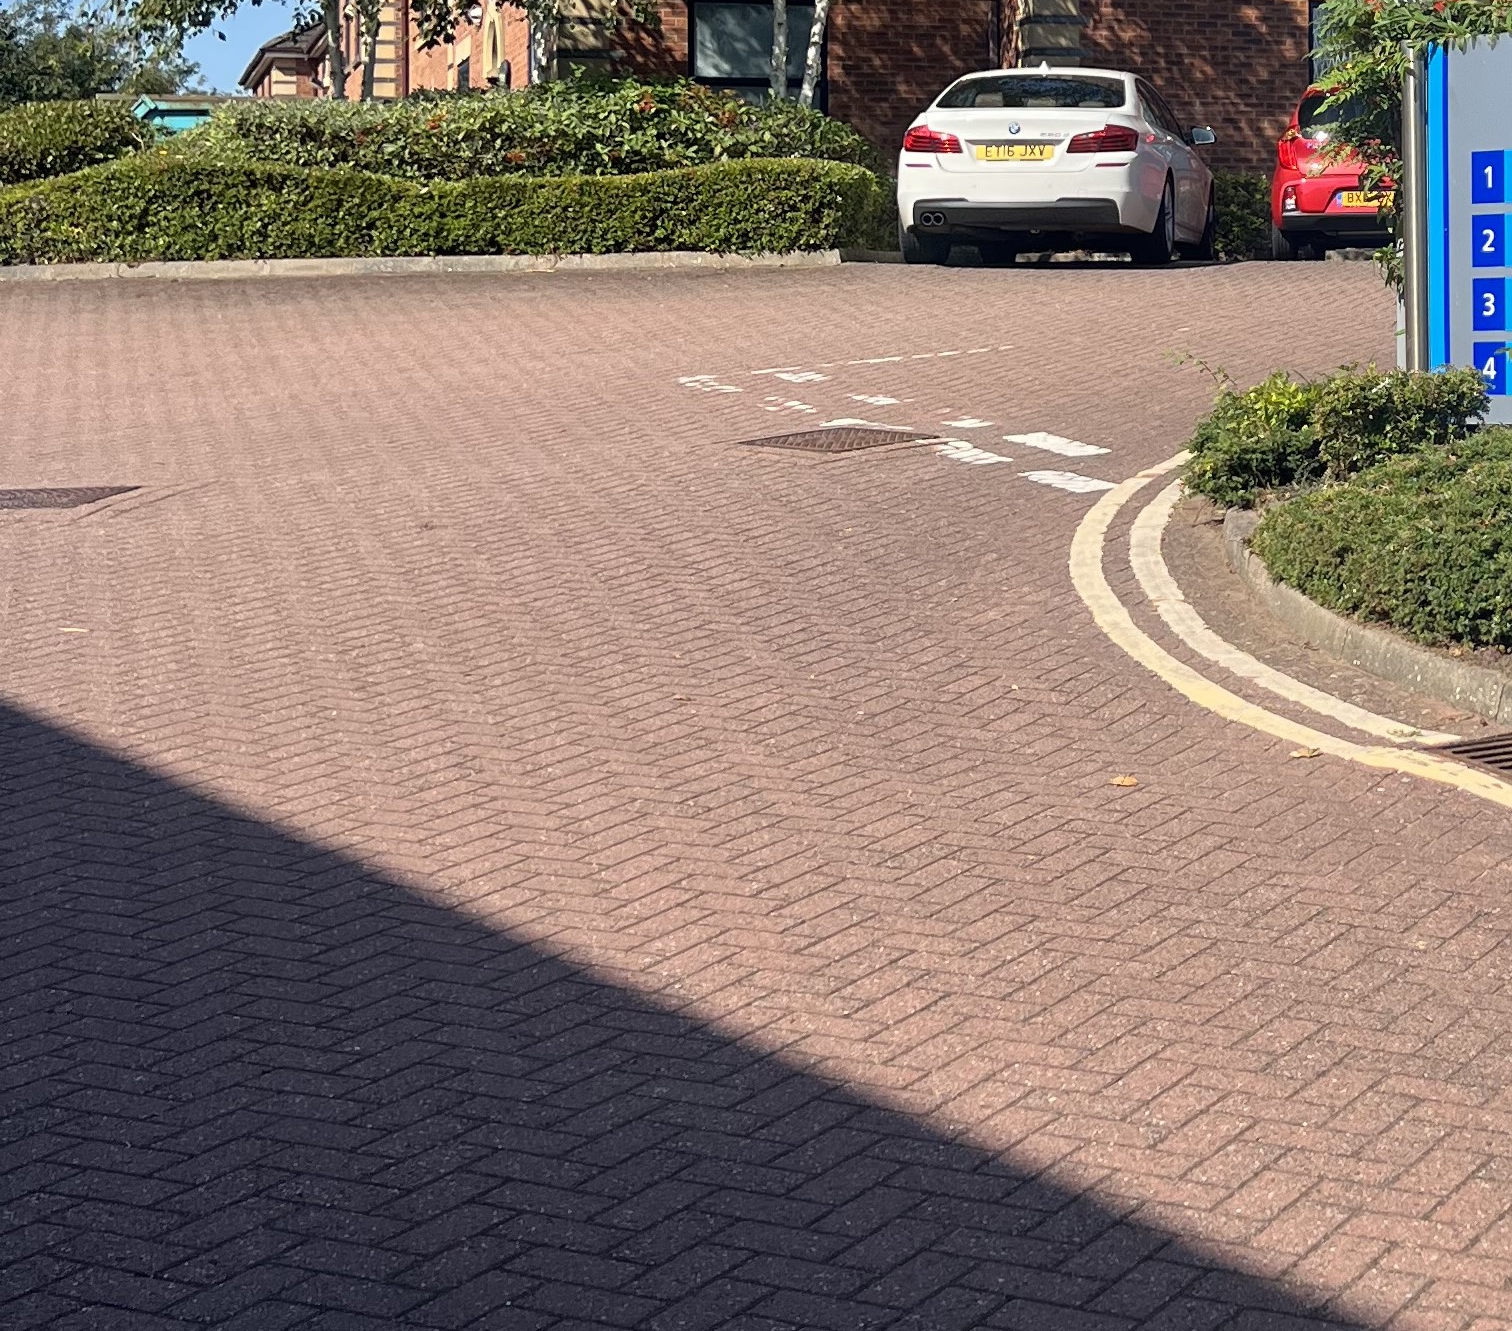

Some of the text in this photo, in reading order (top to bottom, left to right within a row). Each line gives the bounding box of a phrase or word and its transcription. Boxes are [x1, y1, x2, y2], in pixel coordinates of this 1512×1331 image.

[1484, 165, 1493, 188] 1
[1481, 228, 1495, 252] 2
[1482, 292, 1496, 317] 3
[1482, 356, 1497, 380] 4
